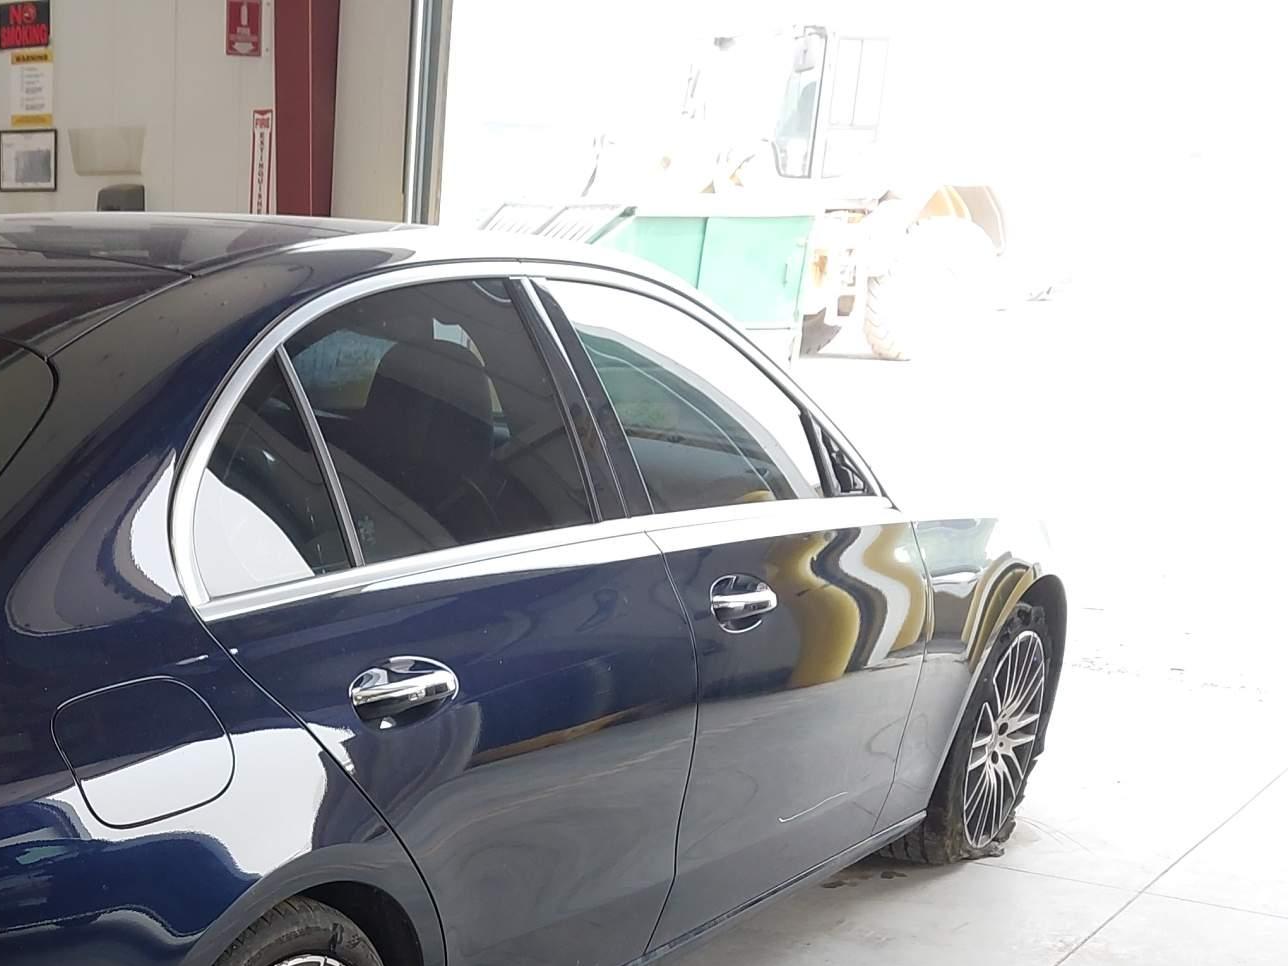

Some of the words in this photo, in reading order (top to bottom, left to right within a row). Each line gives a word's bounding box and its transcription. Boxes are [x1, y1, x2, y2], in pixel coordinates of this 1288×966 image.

[8, 3, 38, 24] NO
[0, 24, 48, 48] SMOKING
[255, 118, 270, 128] FIRE
[256, 131, 265, 214] EXTINGUISHE
